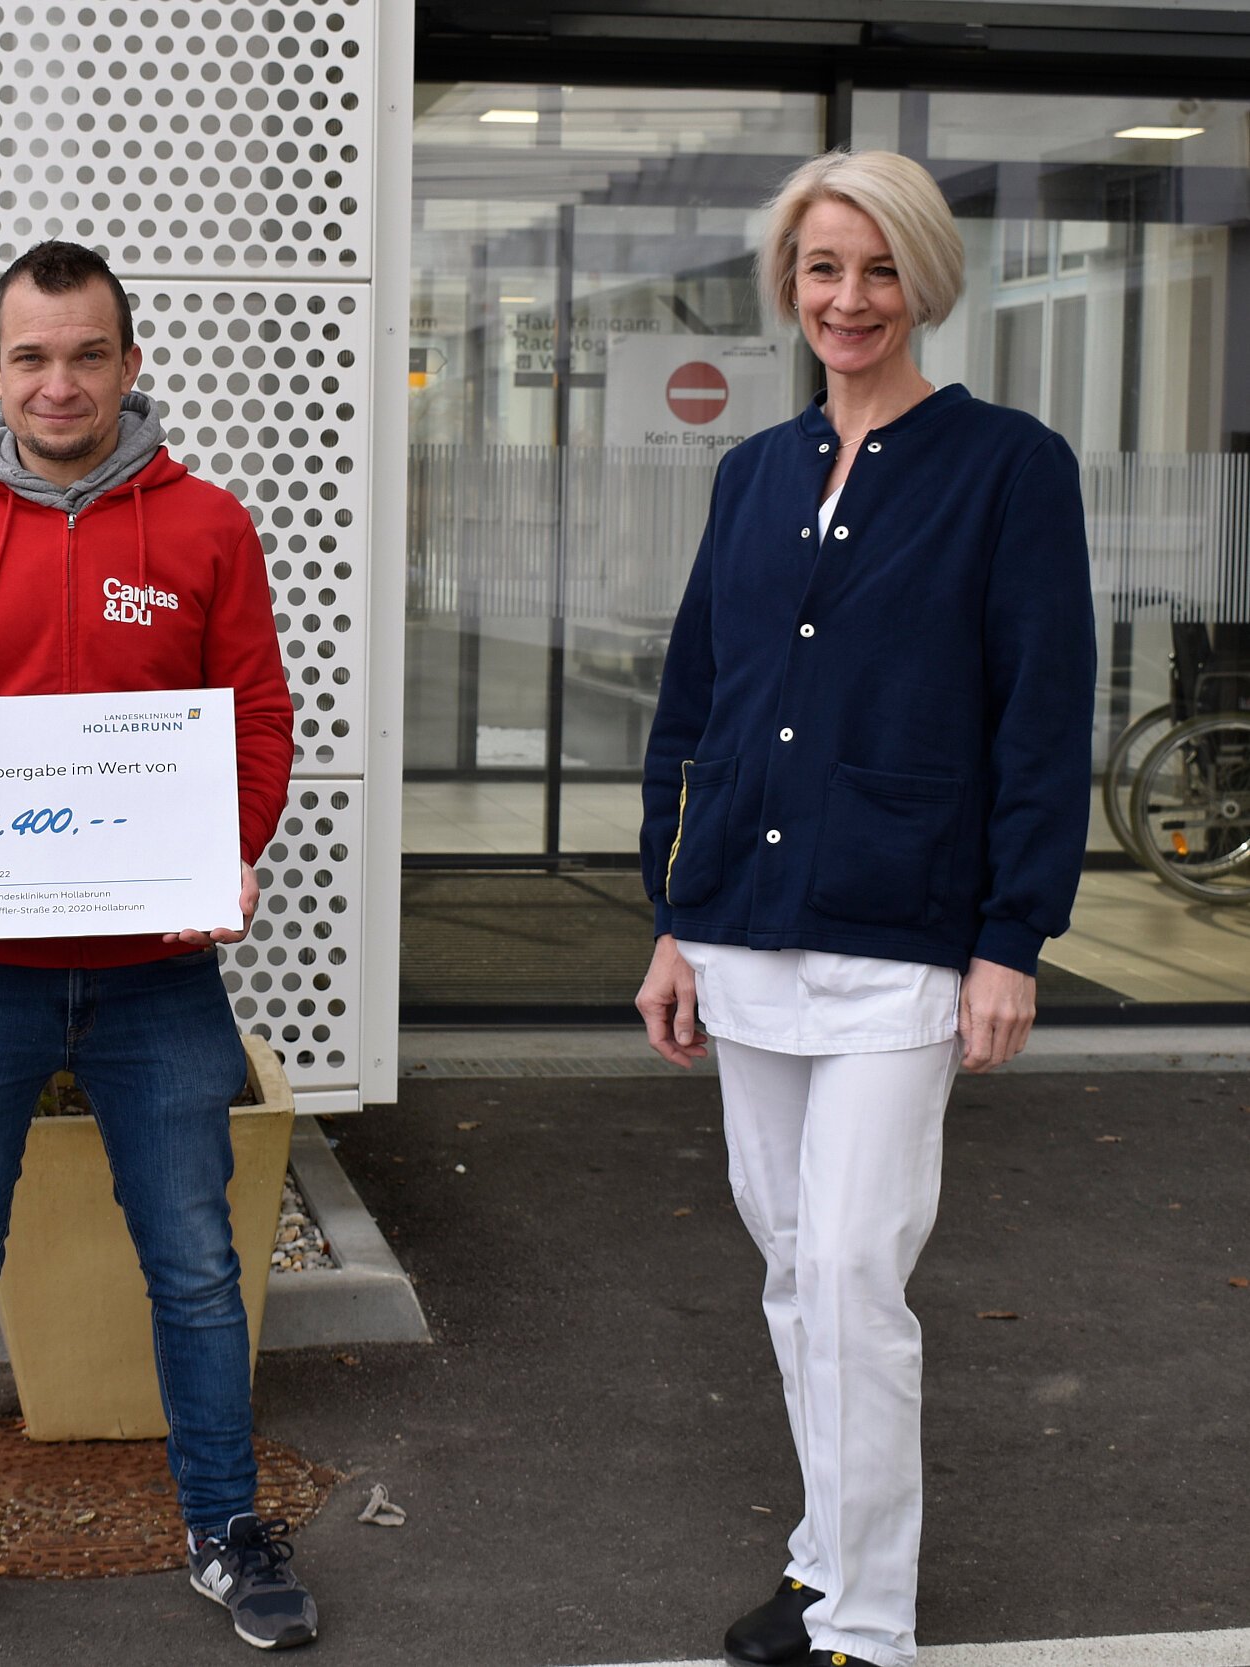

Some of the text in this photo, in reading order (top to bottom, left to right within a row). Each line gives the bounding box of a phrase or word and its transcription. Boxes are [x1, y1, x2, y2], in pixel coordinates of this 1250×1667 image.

[516, 313, 661, 334] Hauteingang
[644, 431, 745, 449] Kein Eingang
[103, 577, 179, 610] Caritas
[103, 599, 152, 626] &Du
[104, 712, 183, 721] LANDESKLINIKUM
[82, 721, 183, 734] HOLLABRUNN
[71, 763, 93, 776] im
[98, 761, 142, 775] Wert
[145, 762, 178, 774] von
[61, 890, 111, 899] Hollabrunn
[52, 905, 66, 914] 20,
[68, 904, 93, 913] 2020
[94, 903, 145, 912] Hollabrunn
